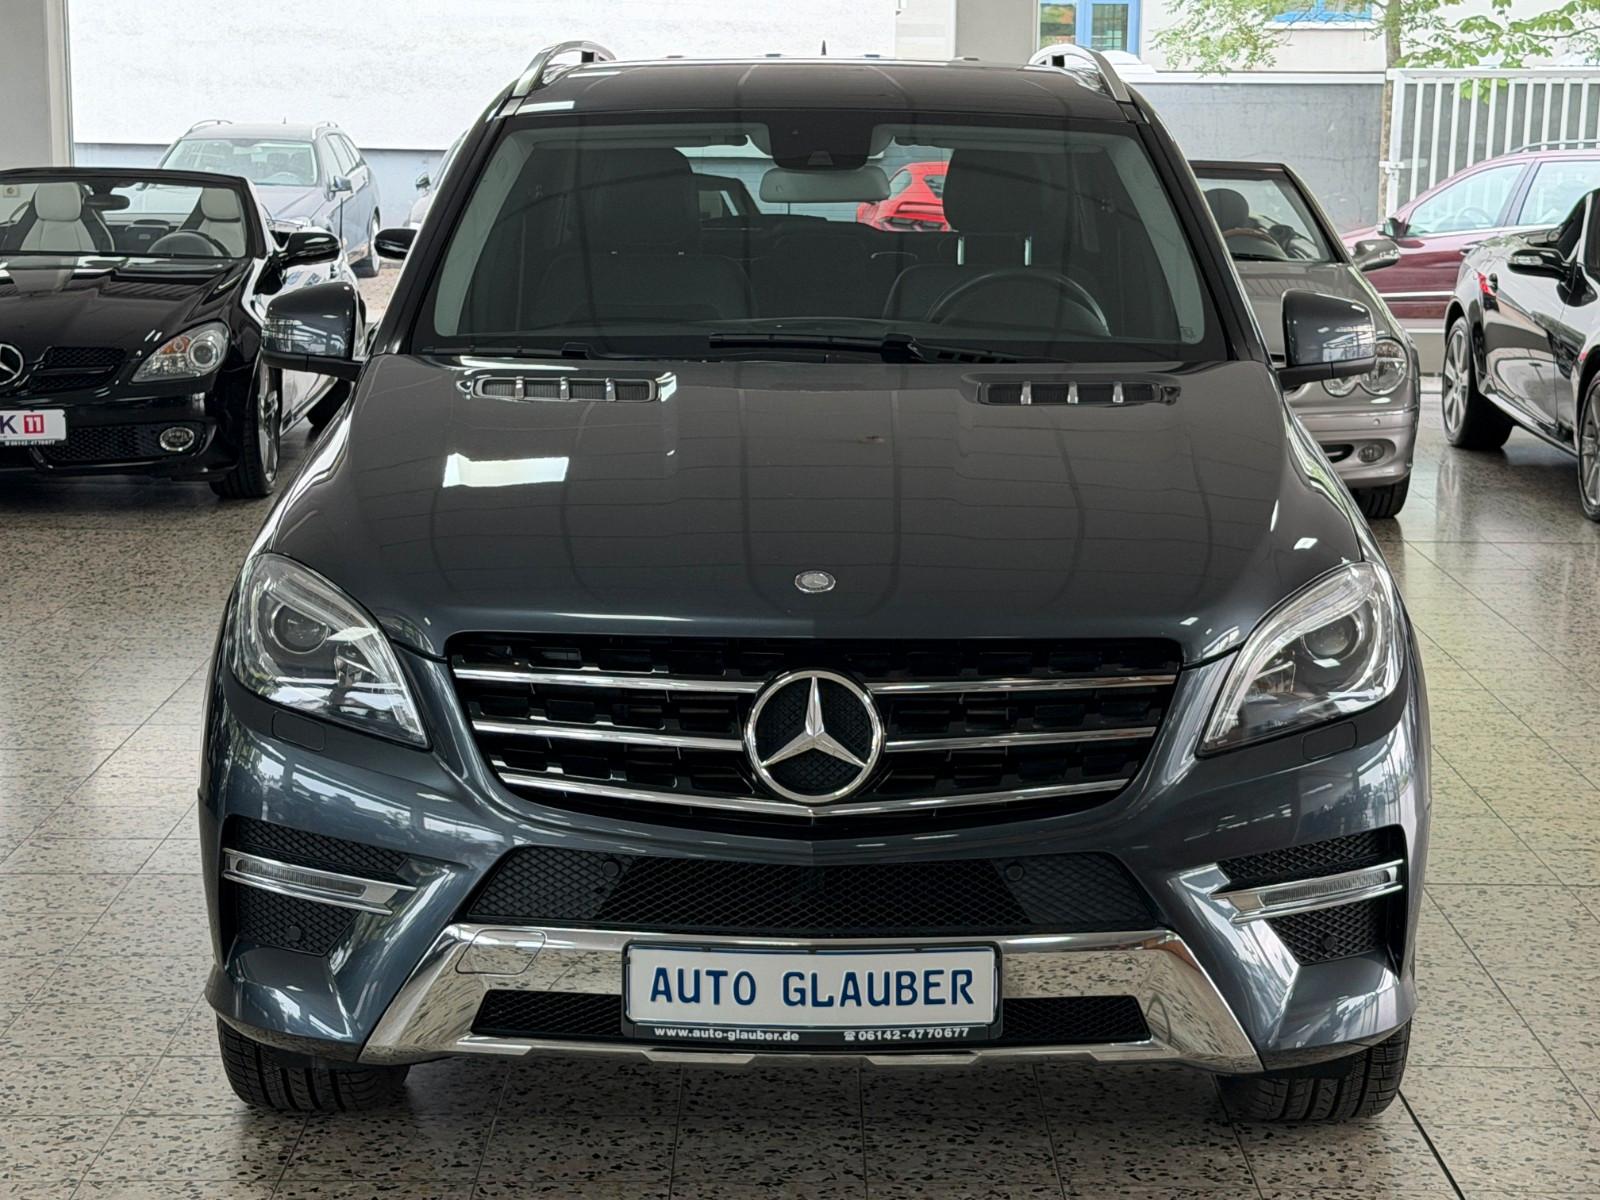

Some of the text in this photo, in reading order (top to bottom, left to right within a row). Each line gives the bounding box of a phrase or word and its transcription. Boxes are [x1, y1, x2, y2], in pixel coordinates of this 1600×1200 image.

[25, 416, 43, 433] 11
[650, 967, 974, 1008] AUTO GLAUBER
[654, 1027, 799, 1041] www.auto-glauber.de
[858, 1027, 969, 1041] 06142-4770677
